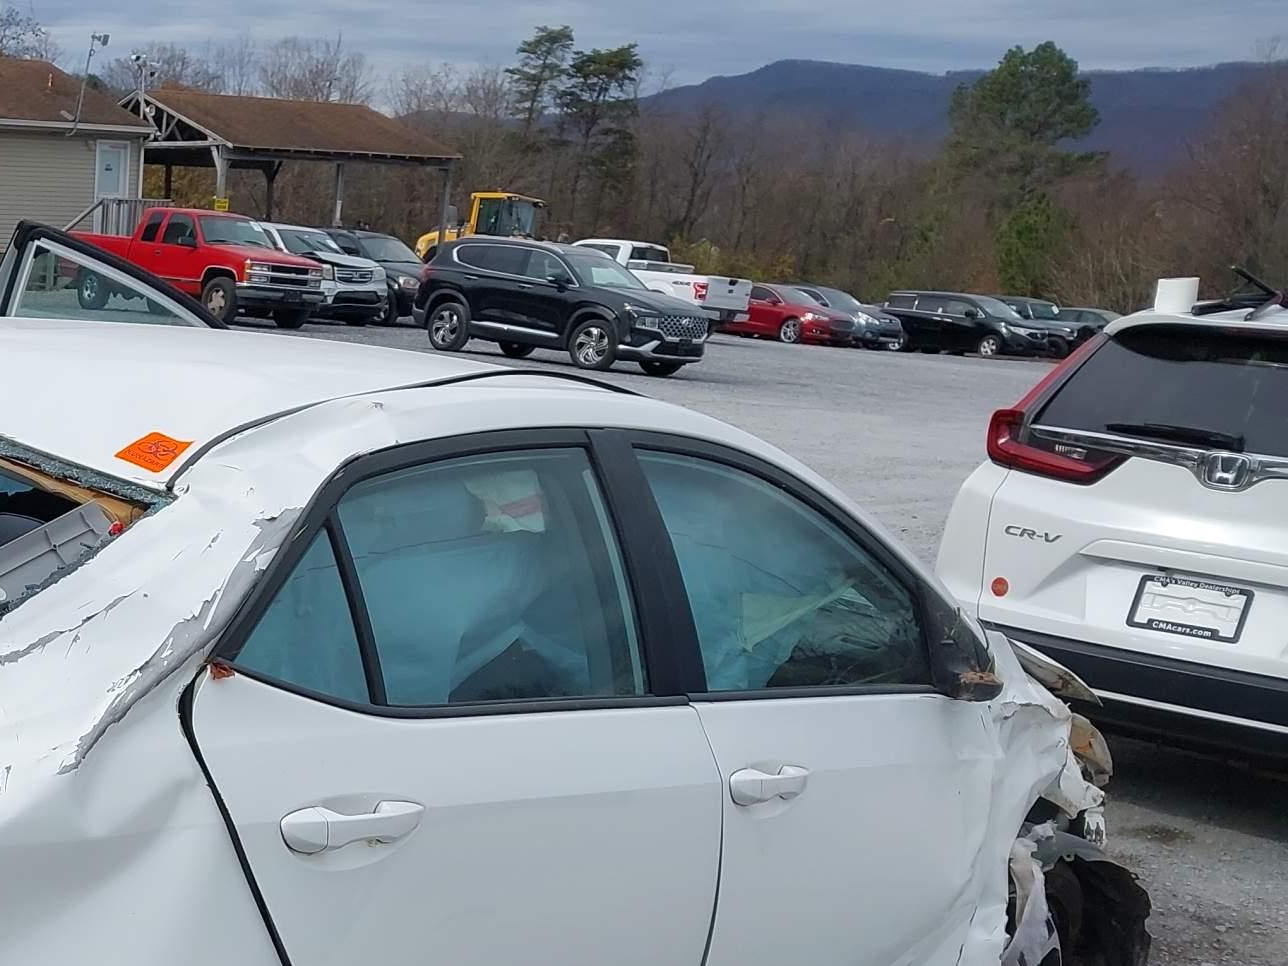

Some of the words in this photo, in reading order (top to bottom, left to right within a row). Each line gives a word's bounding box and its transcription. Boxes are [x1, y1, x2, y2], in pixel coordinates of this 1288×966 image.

[1004, 525, 1063, 543] CR-V
[1177, 578, 1198, 589] Valley
[1199, 583, 1240, 595] Dealerships
[1152, 621, 1212, 637] CMAcars.com
